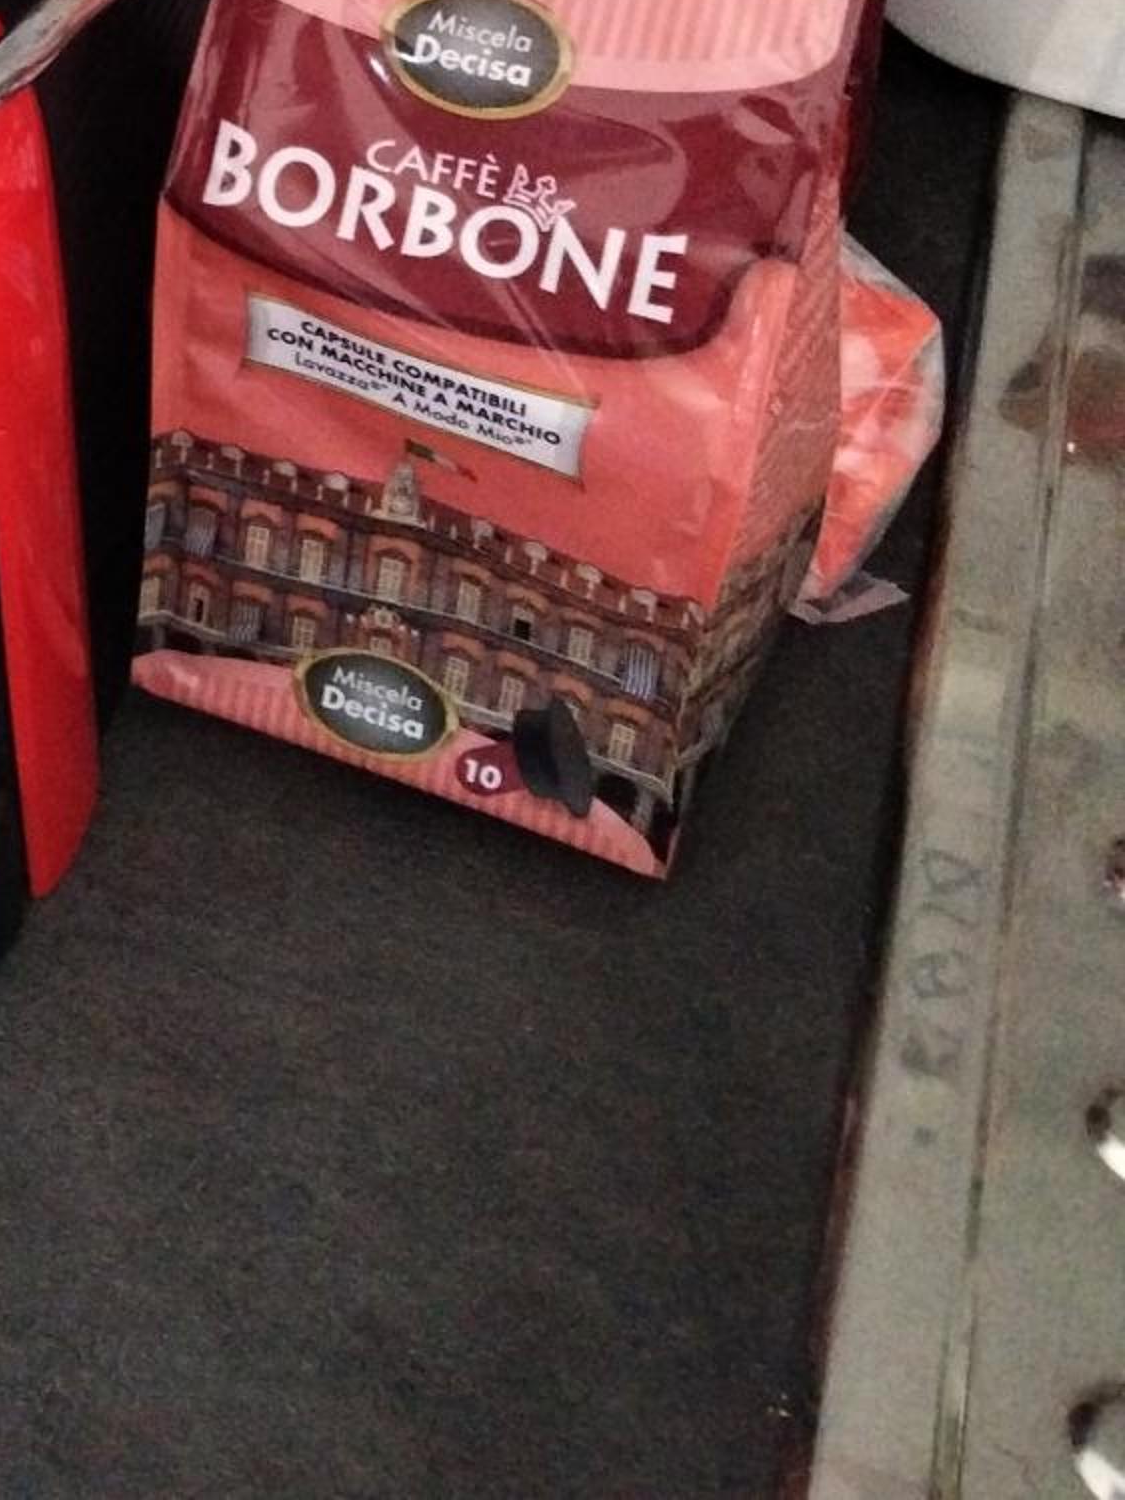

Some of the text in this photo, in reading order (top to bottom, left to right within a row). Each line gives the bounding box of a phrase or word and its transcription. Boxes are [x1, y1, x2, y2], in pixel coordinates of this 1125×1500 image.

[428, 10, 533, 53] Miscela
[411, 34, 532, 87] Decisa
[366, 138, 502, 199] CAFFÈ
[202, 119, 688, 325] BORBONE
[266, 327, 562, 446] CON MACCHINE A MARCHIO
[300, 320, 528, 418] CAPSULE COMPATIBILI
[392, 392, 408, 407] A
[413, 402, 471, 431] Modo
[321, 684, 424, 740] Decisa
[332, 665, 424, 711] Miscela
[464, 758, 503, 789] 10
